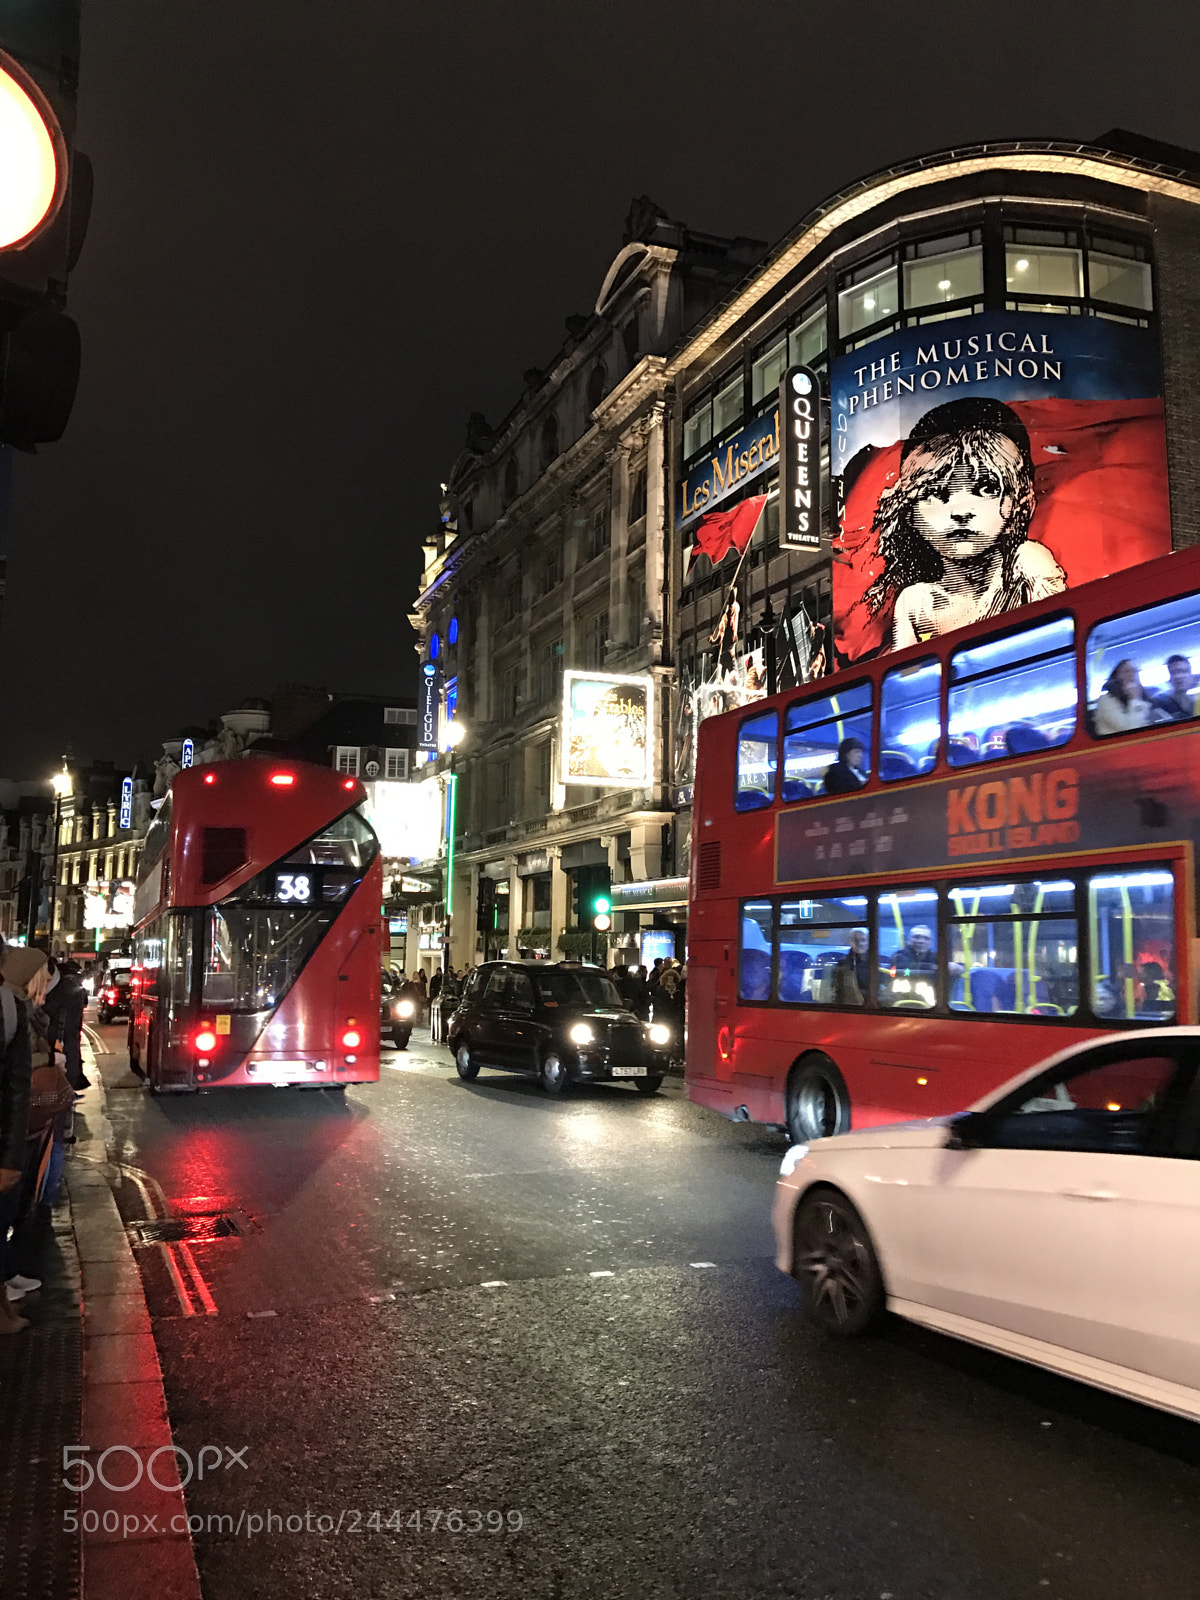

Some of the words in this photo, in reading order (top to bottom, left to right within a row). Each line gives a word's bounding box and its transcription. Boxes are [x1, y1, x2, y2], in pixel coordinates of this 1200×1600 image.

[848, 358, 1063, 416] PHENOMENON
[853, 351, 901, 387] THE
[915, 331, 1054, 366] MUSICAL
[792, 397, 815, 533] QUEENS
[681, 478, 710, 519] Les
[787, 533, 819, 544] THEATRE
[424, 677, 434, 742] GIELGUD
[122, 785, 131, 826] LYRIC
[947, 768, 1079, 835] KONG
[278, 875, 311, 900] 38
